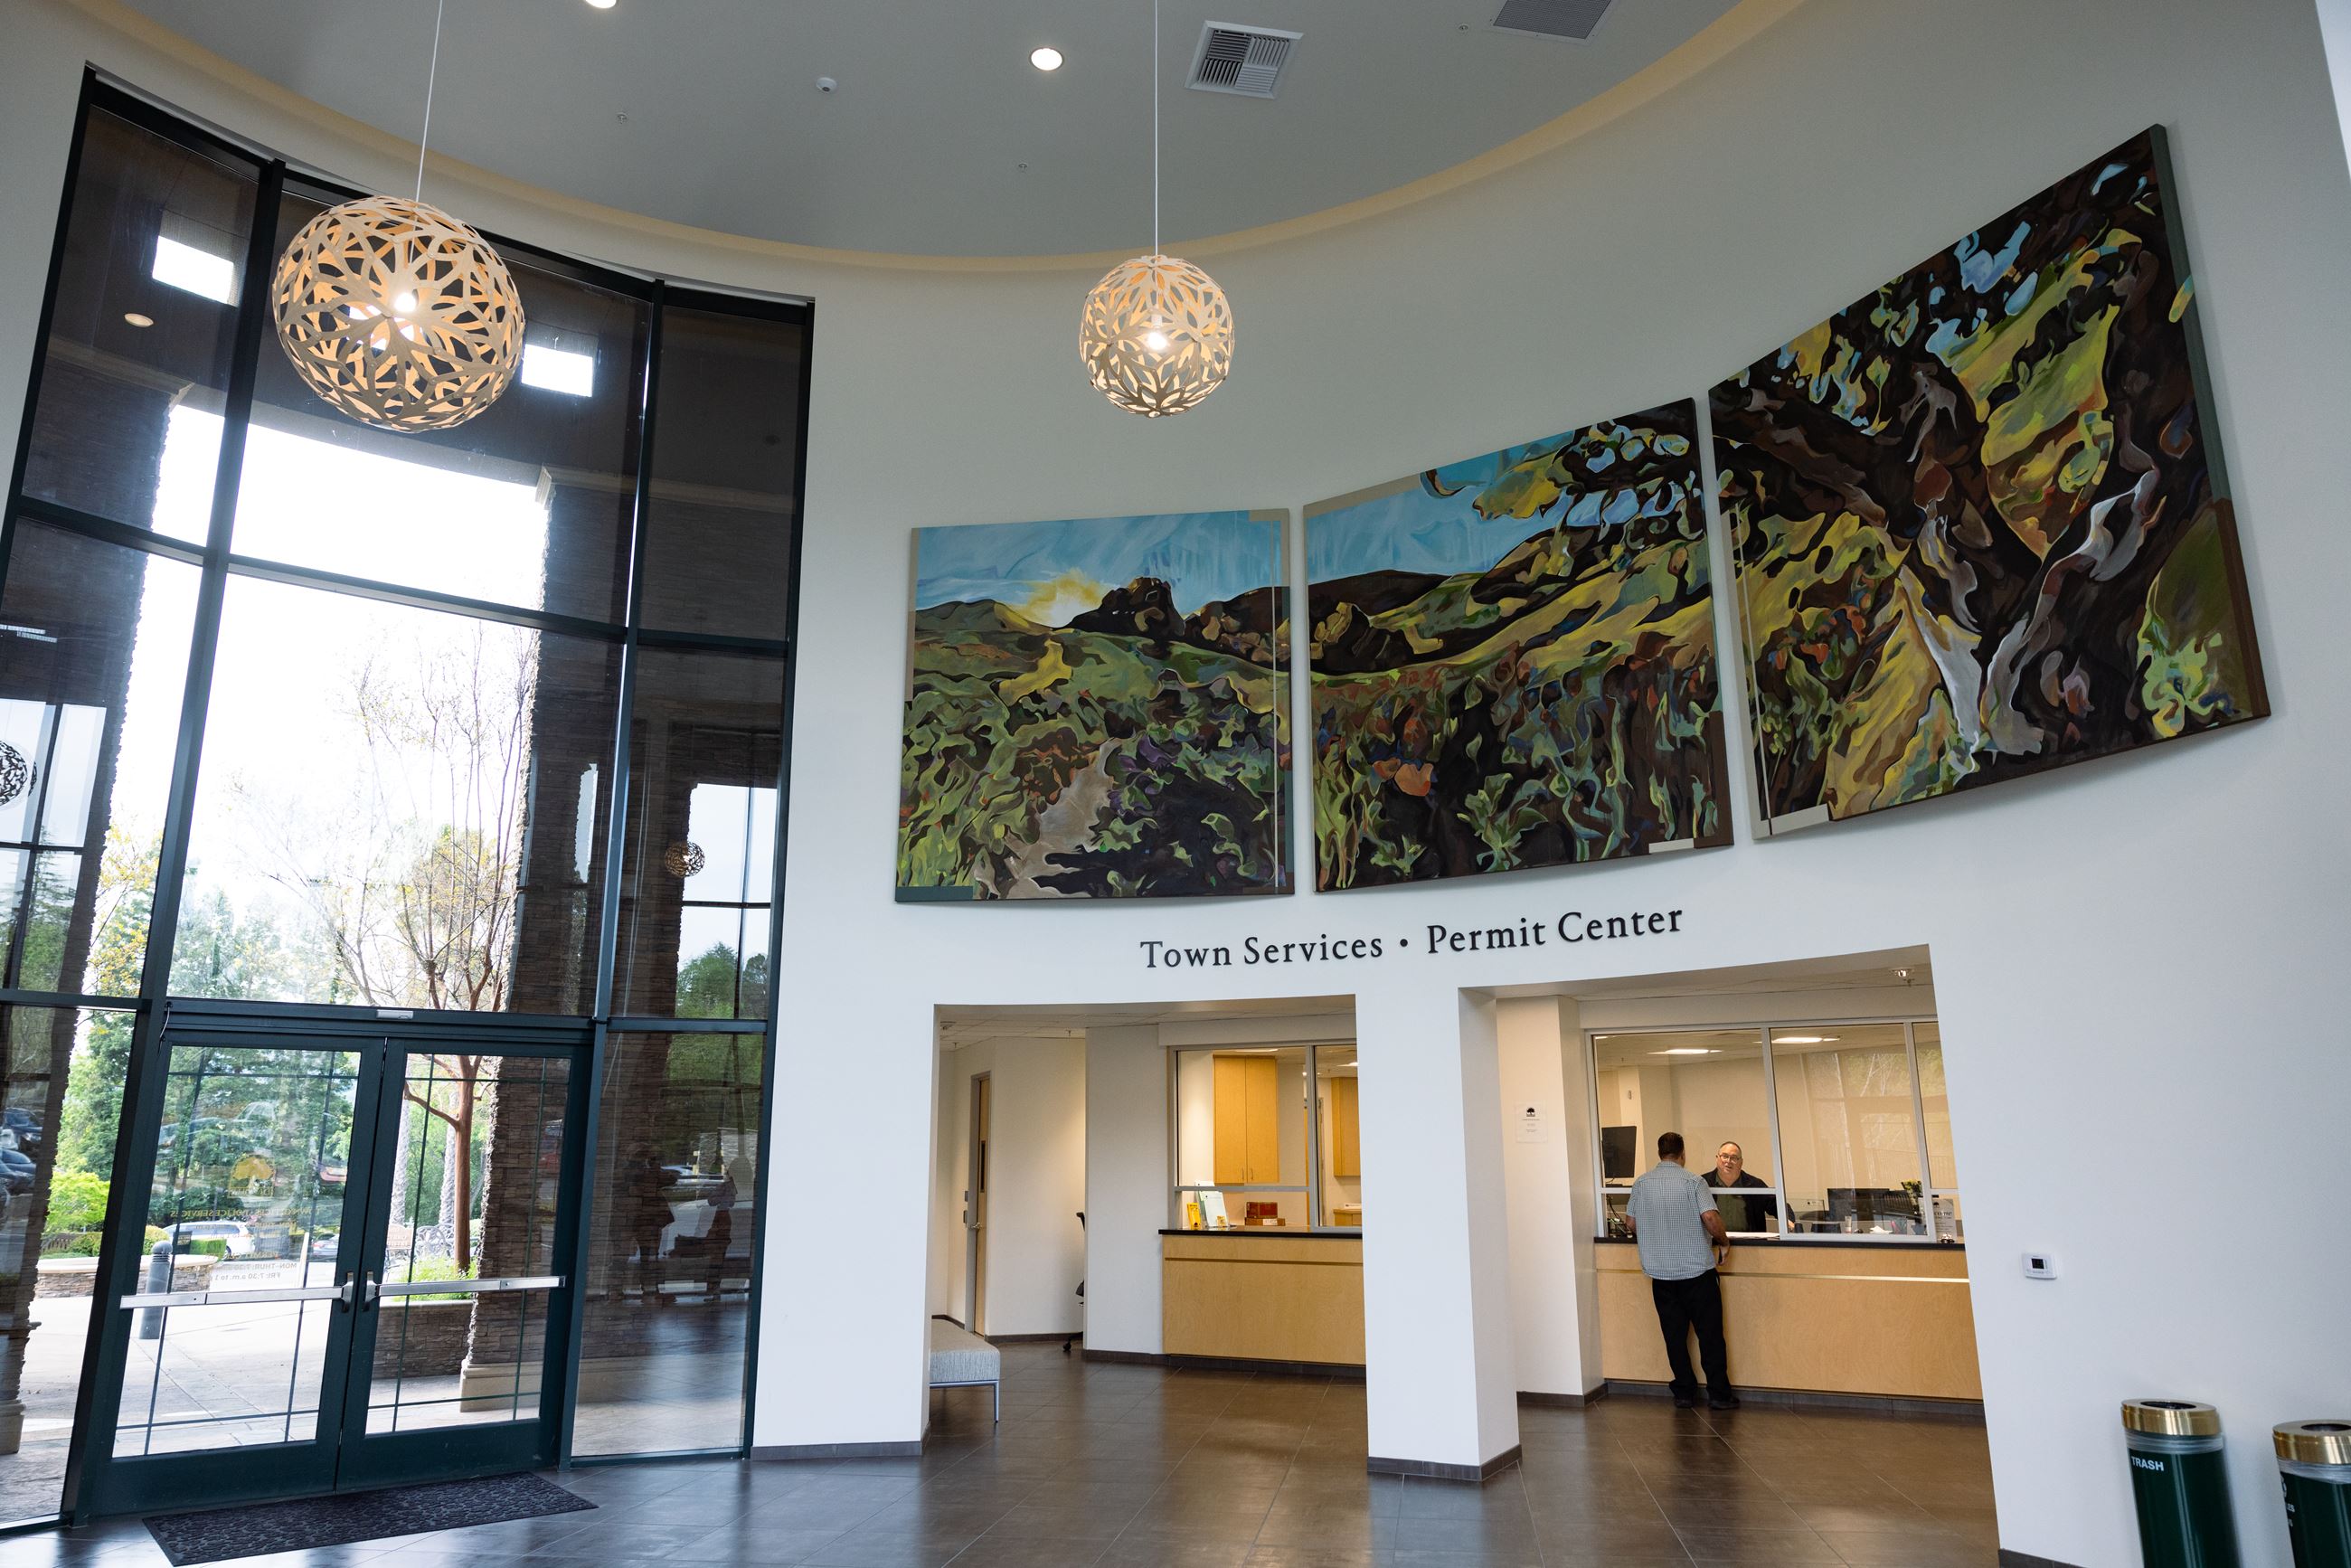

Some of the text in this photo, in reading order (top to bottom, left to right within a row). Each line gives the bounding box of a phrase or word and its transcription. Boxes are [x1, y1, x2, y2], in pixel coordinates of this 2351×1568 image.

[1139, 910, 1684, 968] Town Services Permit Center
[2131, 1456, 2165, 1471] TRASH
